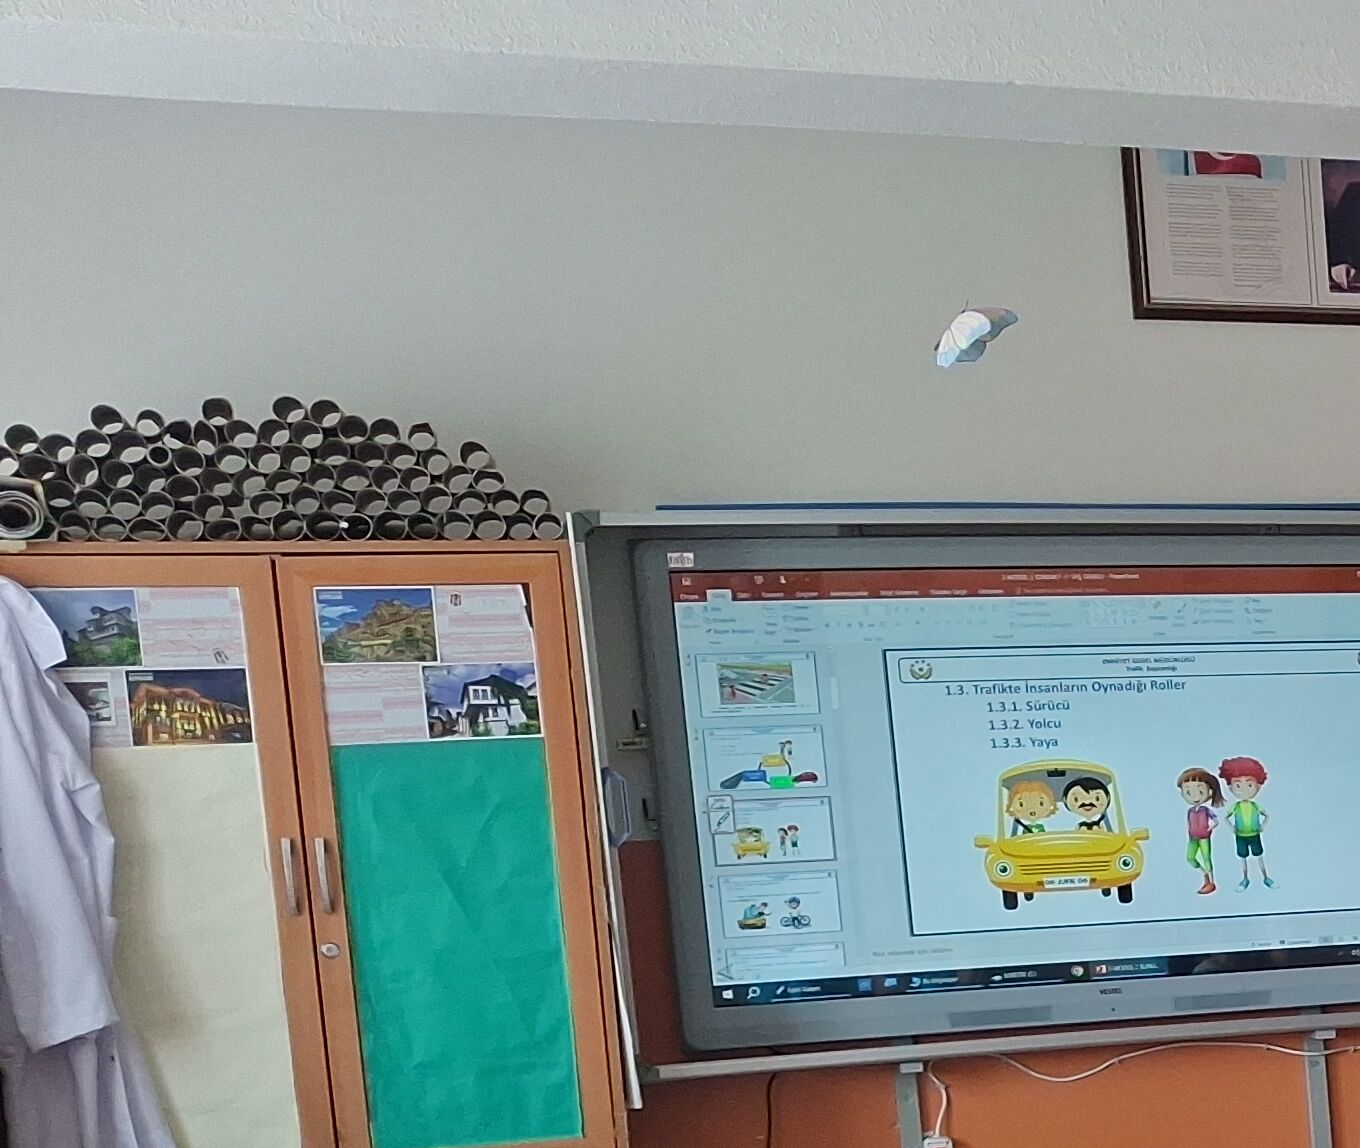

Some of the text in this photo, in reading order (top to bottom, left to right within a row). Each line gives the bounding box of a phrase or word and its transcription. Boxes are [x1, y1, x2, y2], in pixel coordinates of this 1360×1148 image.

[972, 683, 1021, 695] Trafikte
[1025, 680, 1088, 694] İnsanların
[1091, 680, 1147, 694] Oynadığı
[1151, 680, 1186, 691] Roller
[987, 701, 1070, 713] 1.3.1. Sürücü
[988, 718, 1062, 731] 1.3.2. Yolcu
[990, 737, 1059, 749] 1.3.3. Yaya
